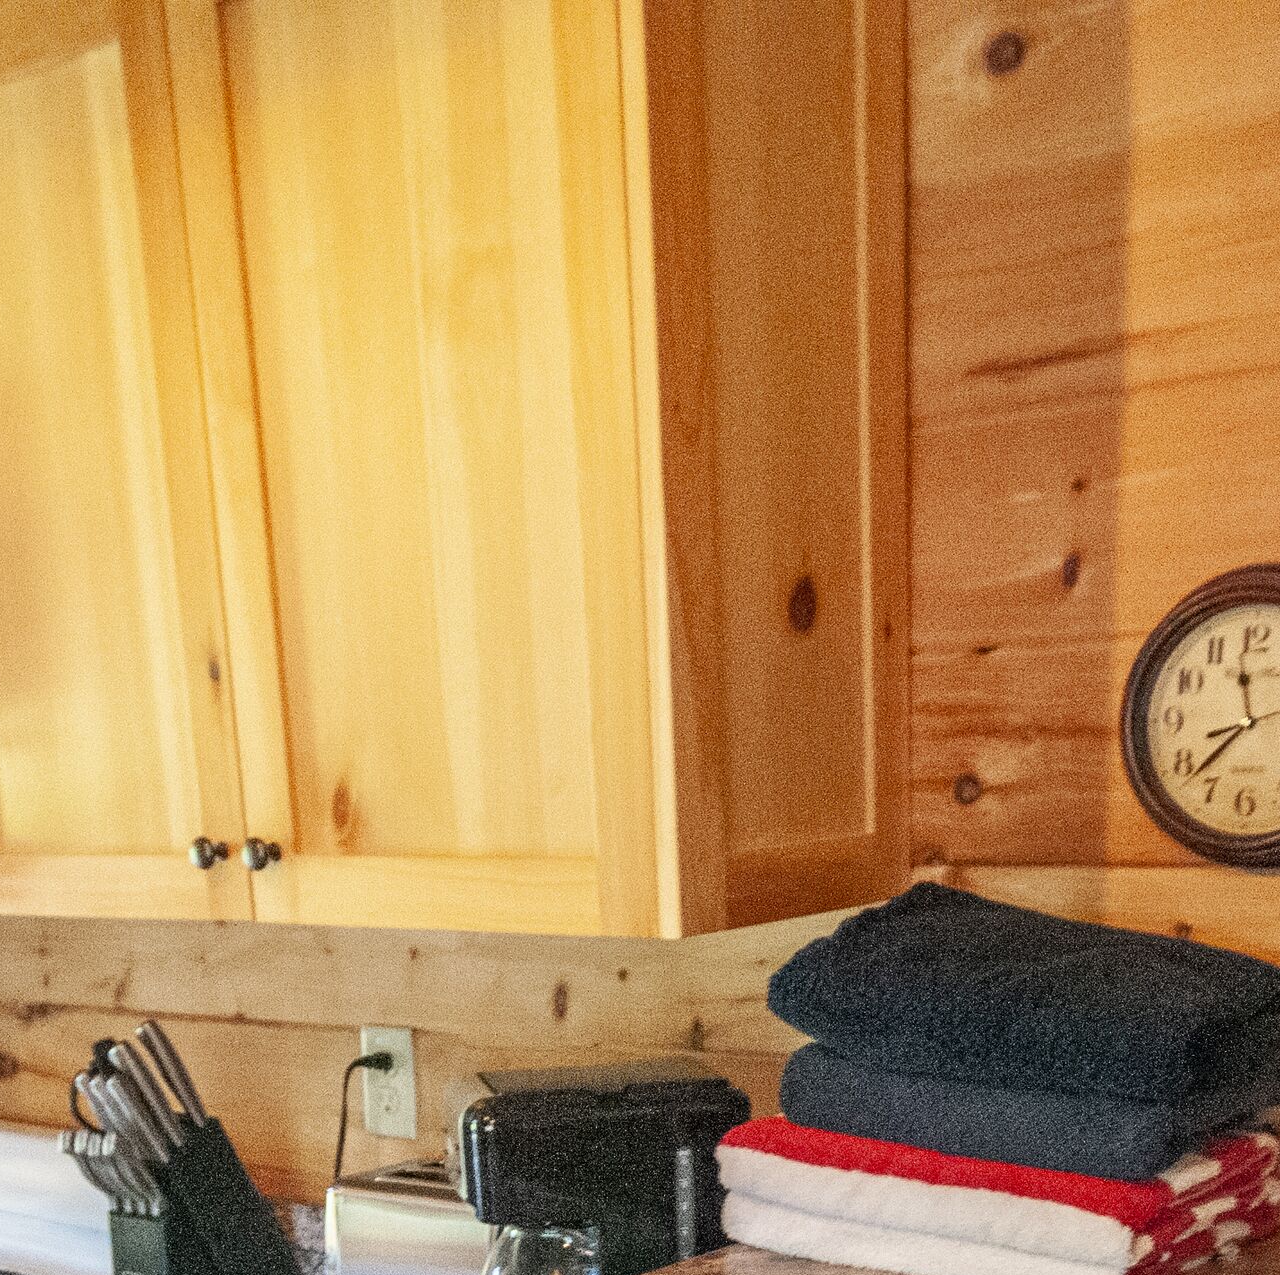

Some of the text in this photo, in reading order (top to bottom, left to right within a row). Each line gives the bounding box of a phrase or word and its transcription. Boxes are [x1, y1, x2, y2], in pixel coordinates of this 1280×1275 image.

[1207, 635, 1225, 666] 11
[1243, 624, 1272, 654] 12
[1177, 667, 1204, 695] 10
[1164, 706, 1184, 735] 9
[1174, 748, 1194, 777] 8
[1204, 776, 1221, 804] 7
[1234, 787, 1257, 818] 6
